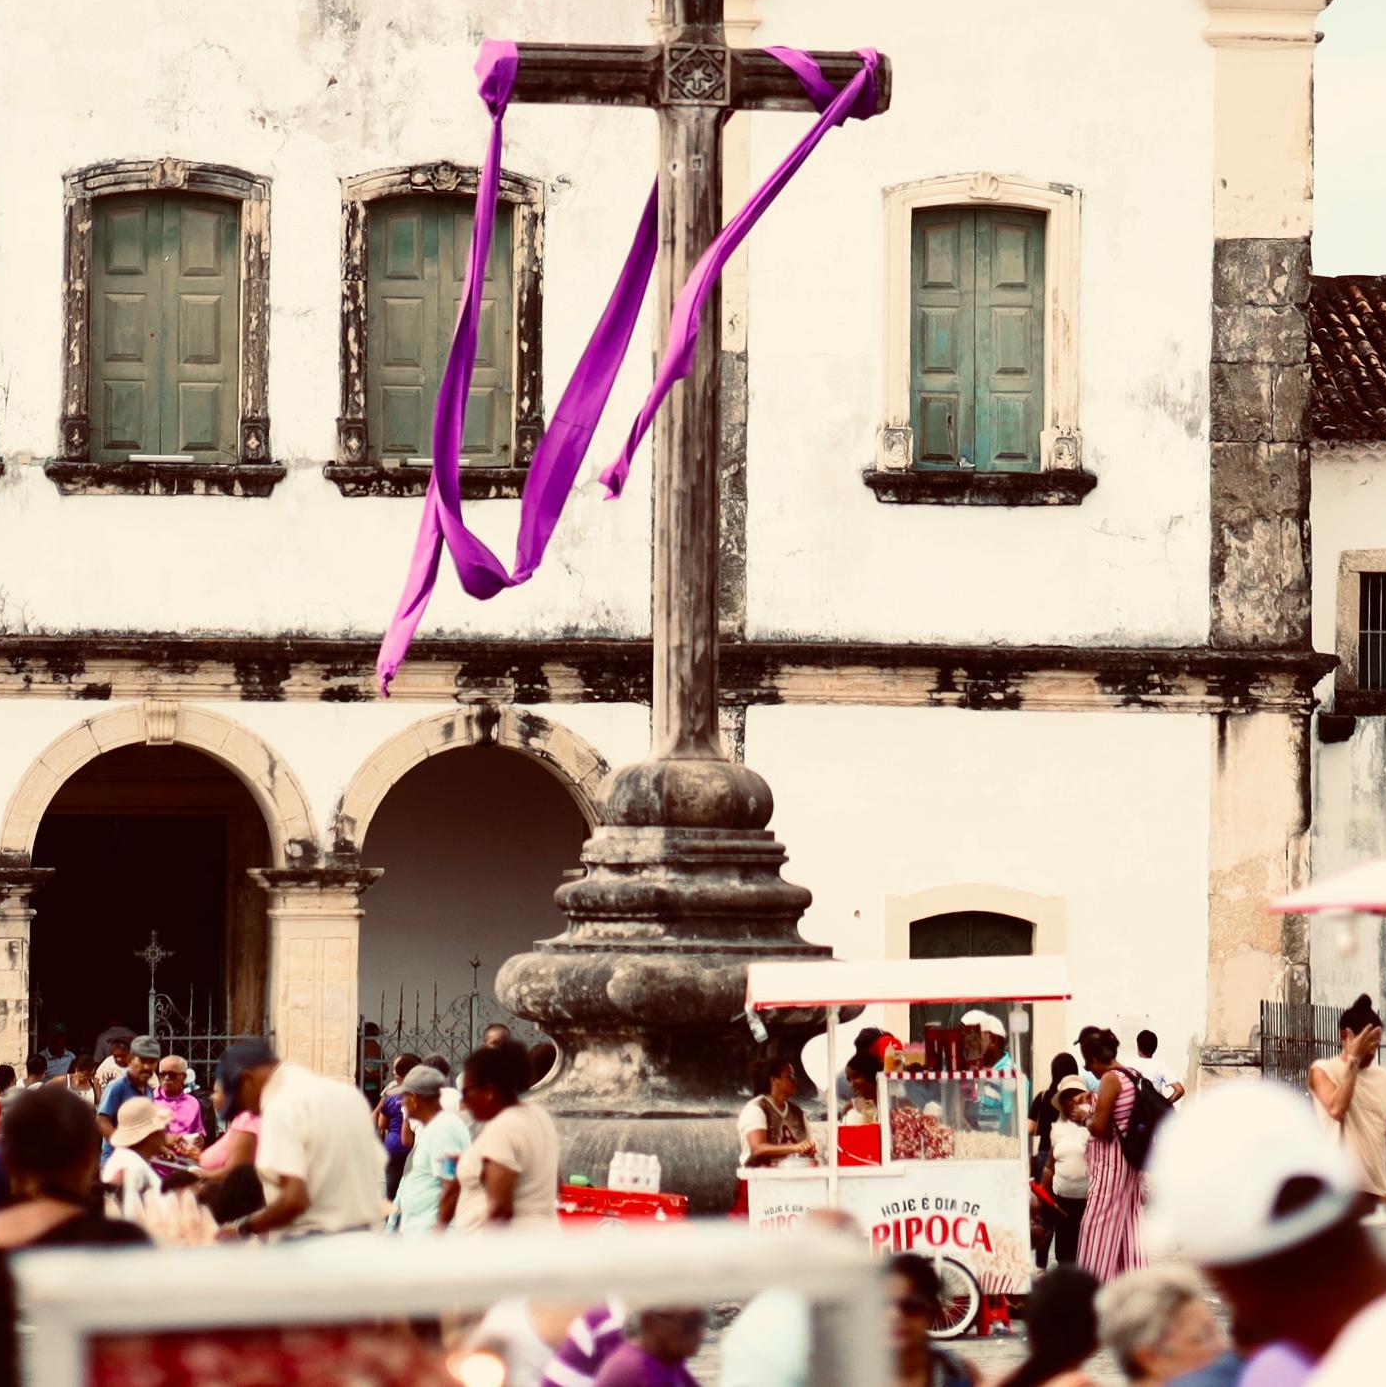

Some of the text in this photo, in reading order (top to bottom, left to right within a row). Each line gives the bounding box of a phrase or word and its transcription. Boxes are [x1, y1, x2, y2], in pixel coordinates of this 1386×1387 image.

[881, 1193, 980, 1217] HOJE É DIA DE
[872, 1214, 993, 1255] PIPOCA
